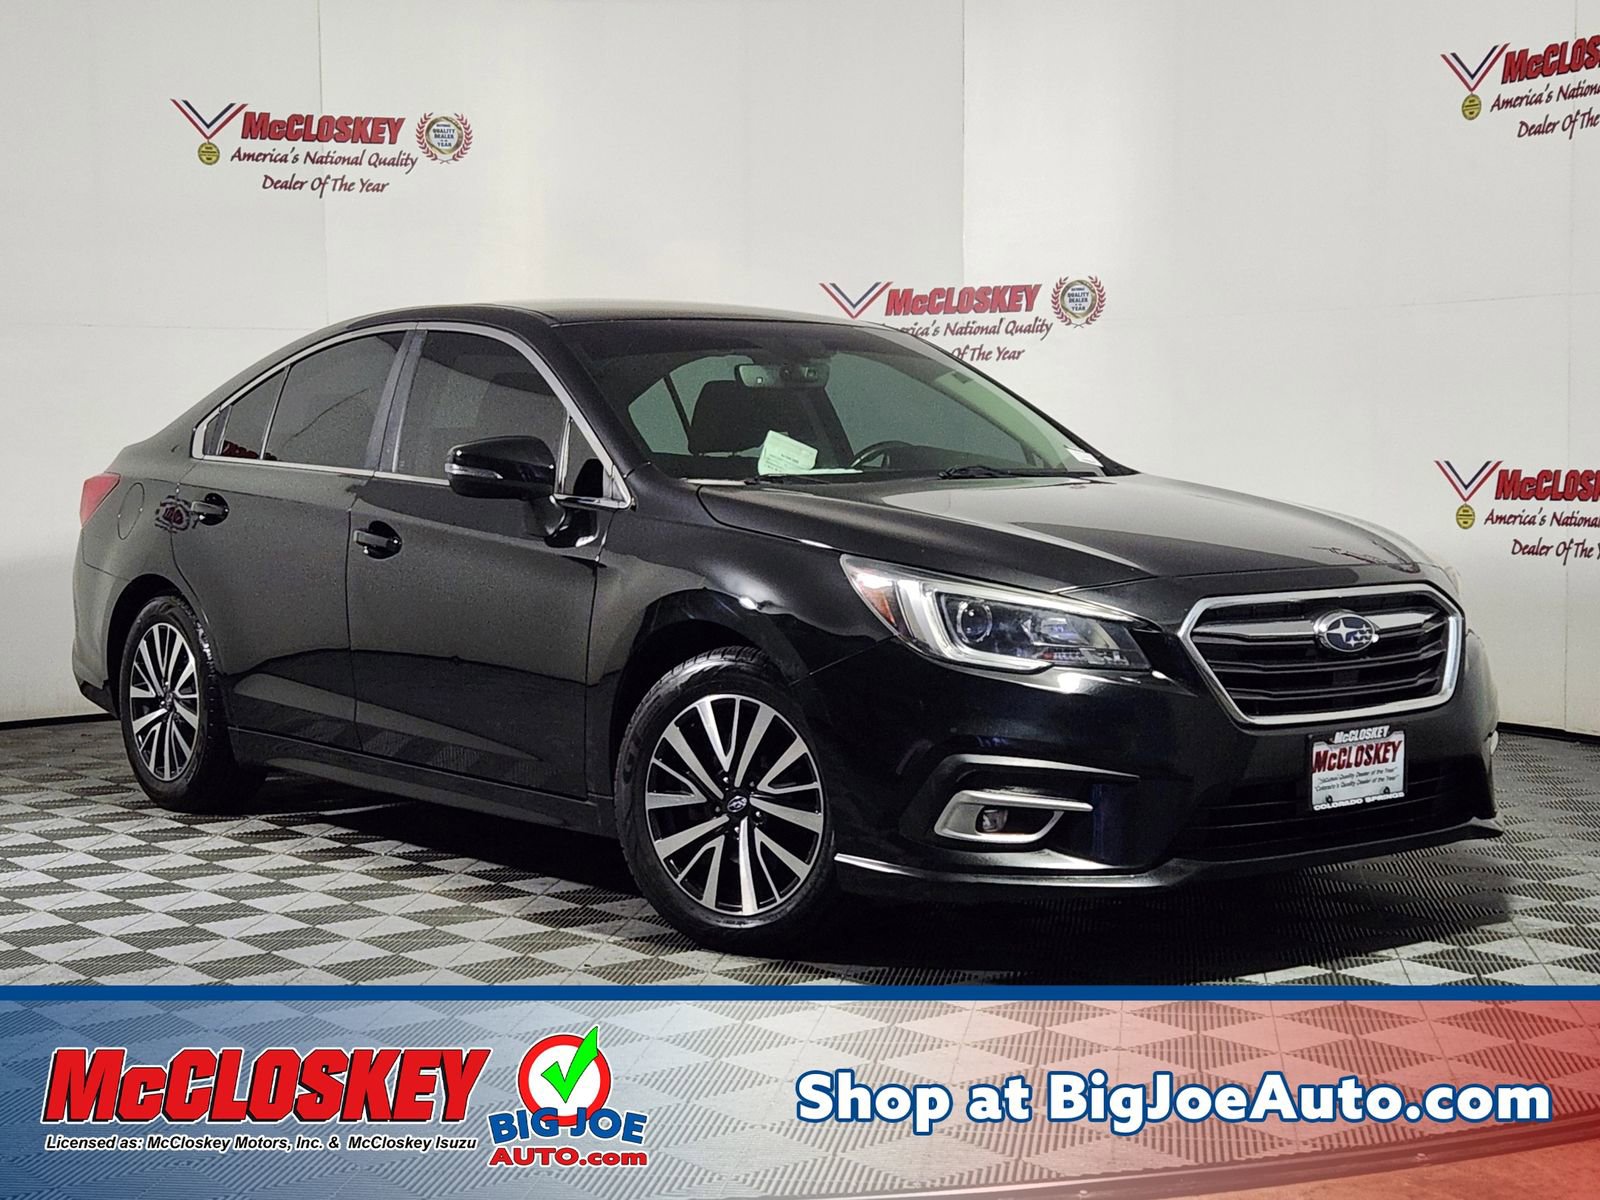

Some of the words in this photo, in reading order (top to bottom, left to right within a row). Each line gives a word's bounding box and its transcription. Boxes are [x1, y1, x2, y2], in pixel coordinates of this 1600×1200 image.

[1490, 83, 1553, 112] America's
[241, 111, 406, 145] McCLOSKEY
[1517, 114, 1560, 138] Dealer
[1562, 109, 1580, 140] Of
[230, 147, 299, 165] America's
[304, 149, 363, 167] National
[368, 151, 418, 174] Quality
[262, 174, 308, 191] Dealer
[311, 174, 330, 198] Of
[331, 174, 356, 192] The
[360, 177, 389, 193] Year
[884, 284, 1042, 316] McCLOSKEY
[944, 318, 1004, 336] National
[1005, 316, 1053, 341] Quality
[970, 344, 993, 361] The
[994, 346, 1025, 361] Year
[1484, 507, 1547, 526] America's
[1550, 510, 1600, 528] Nationa
[1511, 537, 1554, 557] Dealer
[1556, 538, 1574, 566] Of
[1574, 538, 1594, 558] The
[1334, 725, 1390, 744] McCLOSKEY
[1312, 740, 1403, 774] McCLOSKEY
[1313, 798, 1363, 811] COLORADO
